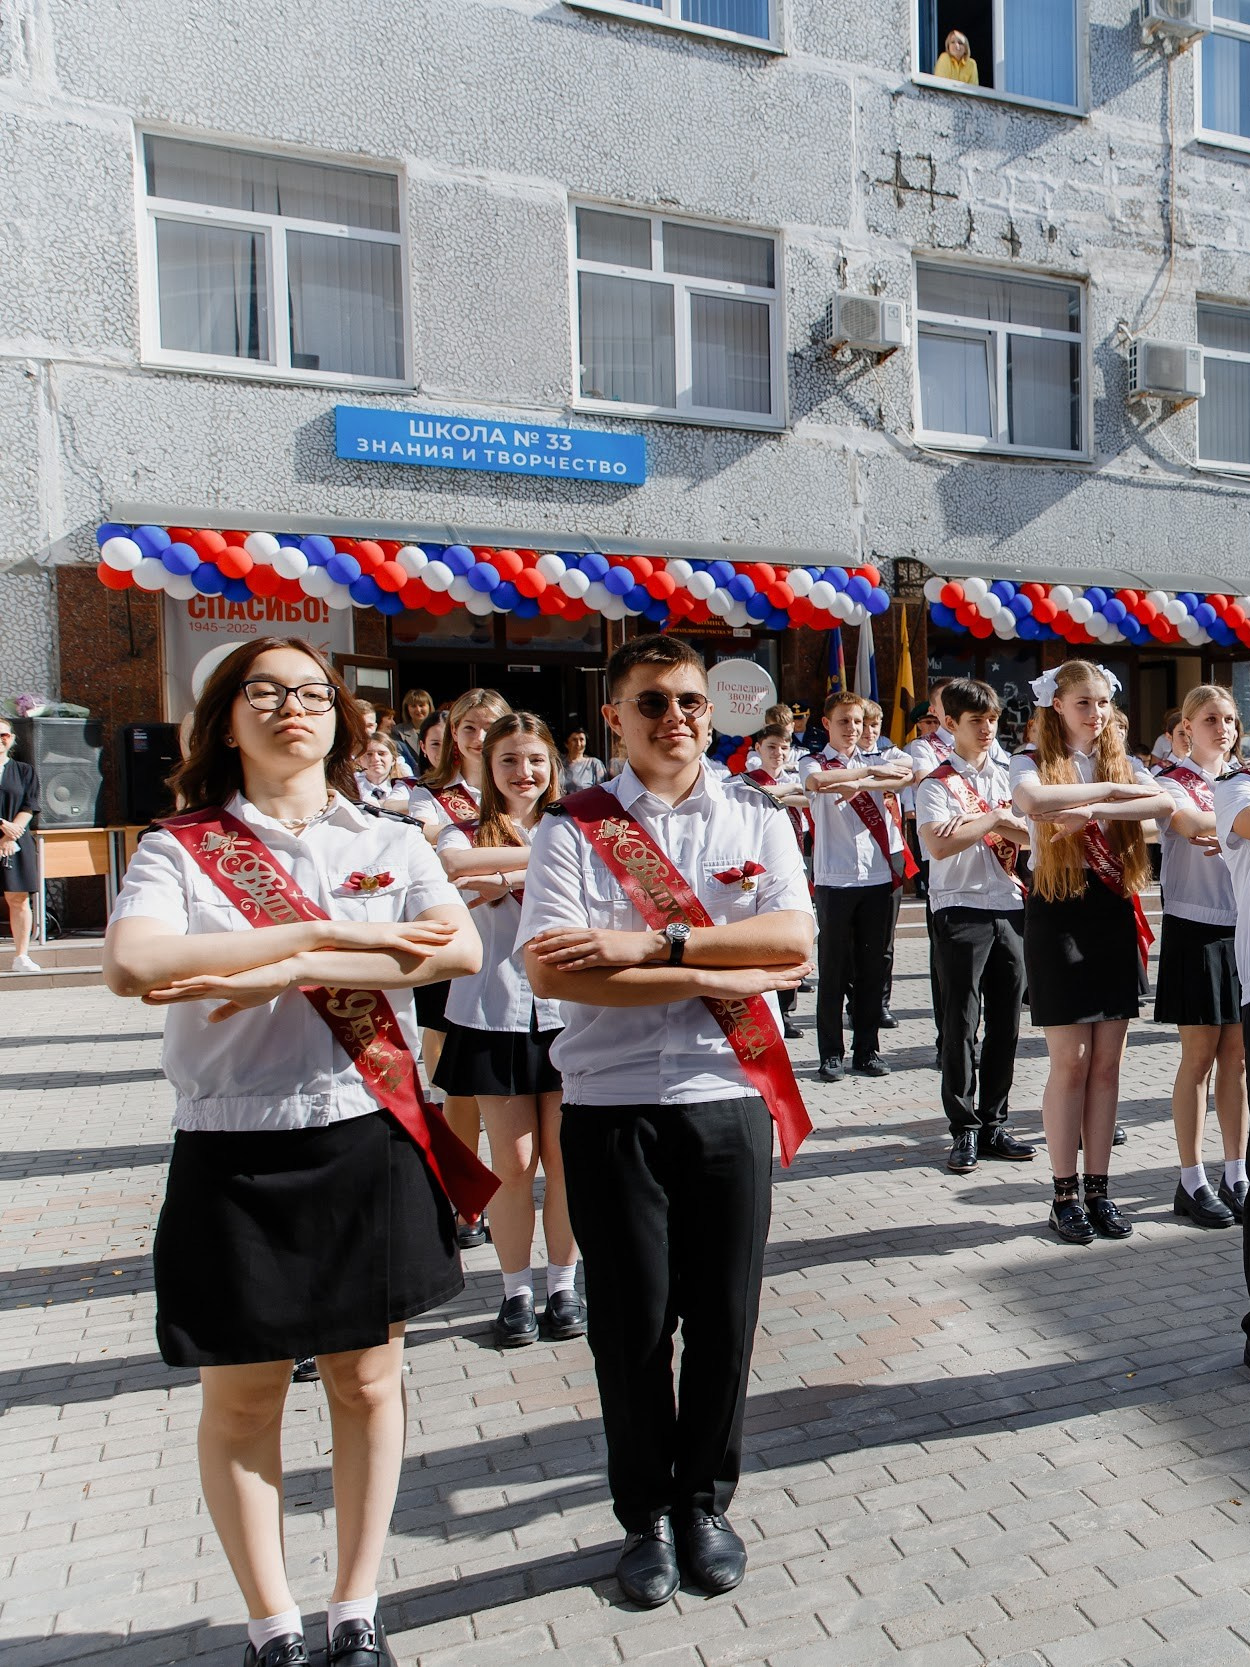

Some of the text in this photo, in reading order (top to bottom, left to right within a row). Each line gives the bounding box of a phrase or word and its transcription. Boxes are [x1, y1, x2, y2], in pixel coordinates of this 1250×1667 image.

[409, 419, 573, 451] ШКОЛА № 33
[357, 437, 627, 475] ЗНАНИЯ И ТВОРЧЕСТВО
[187, 593, 330, 623] СПАСИБО!
[717, 681, 769, 695] Последний
[326, 991, 378, 1019] 9
